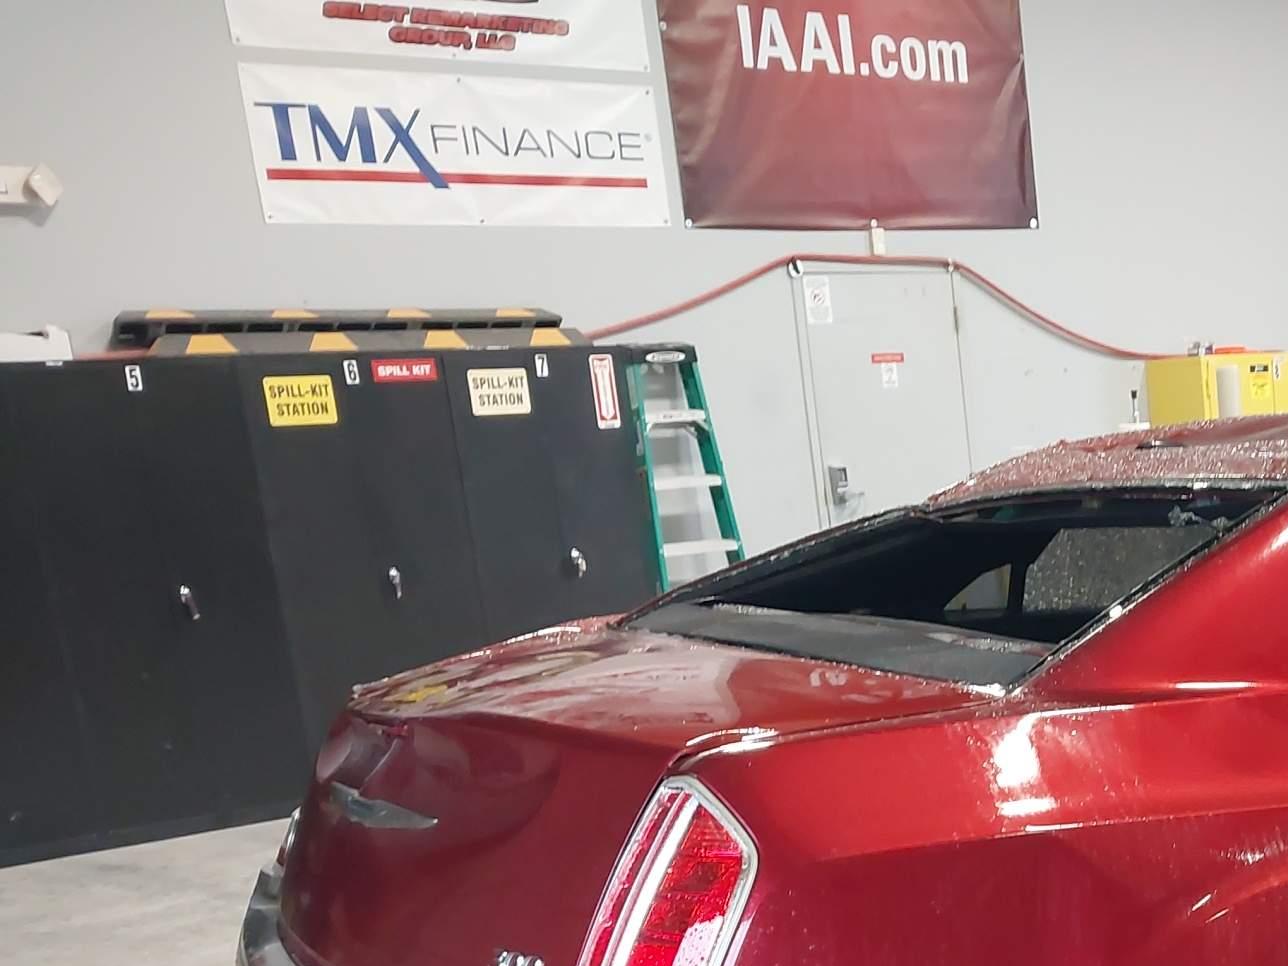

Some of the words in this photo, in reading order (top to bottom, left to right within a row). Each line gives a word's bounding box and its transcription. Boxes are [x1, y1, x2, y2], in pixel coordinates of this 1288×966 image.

[736, 4, 969, 84] IAAI.com
[346, 361, 357, 383] 6
[377, 364, 410, 378] SPILL
[412, 363, 432, 377] KIT
[536, 355, 546, 377] 7
[128, 367, 139, 388] 5
[471, 375, 525, 390] SPILL-KIT
[268, 383, 330, 399] SPILL-KIT
[478, 392, 524, 407] STATION
[276, 401, 329, 417] STATION
